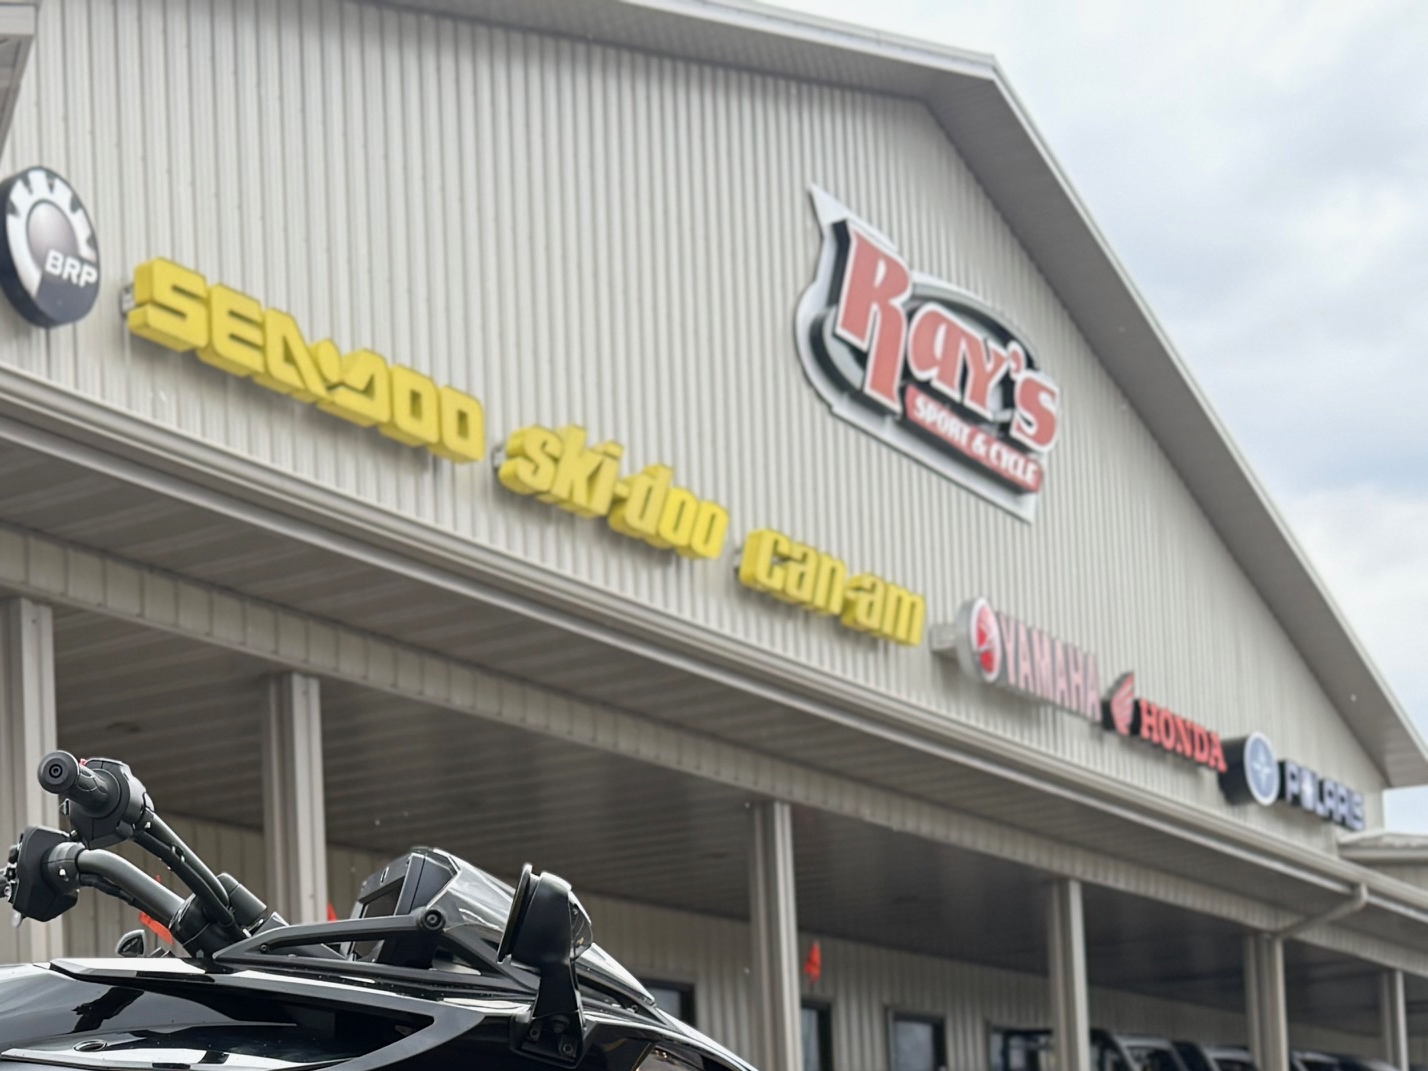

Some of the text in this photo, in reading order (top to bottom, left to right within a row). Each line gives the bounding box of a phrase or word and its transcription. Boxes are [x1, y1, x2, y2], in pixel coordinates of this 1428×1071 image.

[44, 249, 98, 288] BRP
[914, 393, 971, 447] SPORT
[990, 441, 1038, 486] CYCLE
[999, 612, 1102, 722] YAMAHA
[1138, 697, 1228, 774] HONDA
